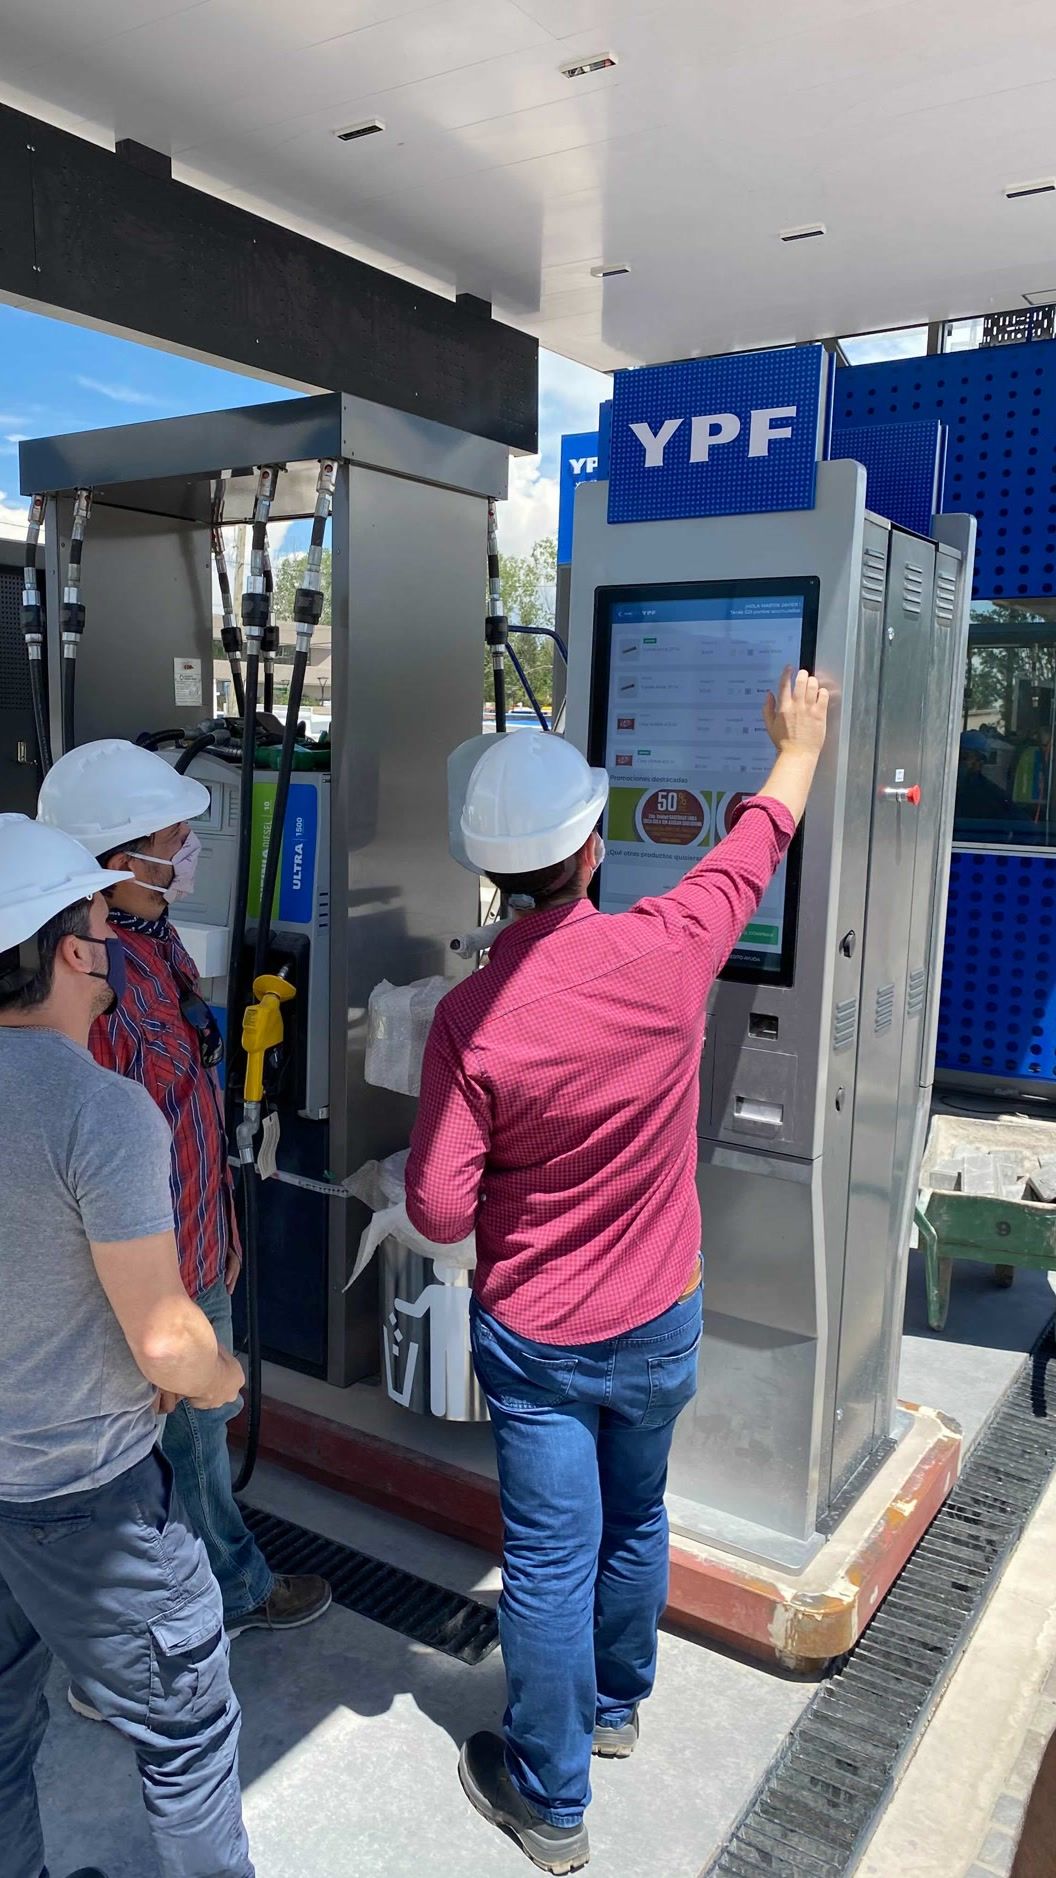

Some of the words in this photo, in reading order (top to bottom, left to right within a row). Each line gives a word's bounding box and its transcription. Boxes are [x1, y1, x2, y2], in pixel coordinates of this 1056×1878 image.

[628, 405, 797, 468] YPF
[568, 456, 599, 475] YP
[651, 776, 688, 784] destacadas
[263, 800, 271, 811] 10
[295, 816, 303, 837] 1500
[292, 843, 304, 890] ULTRA
